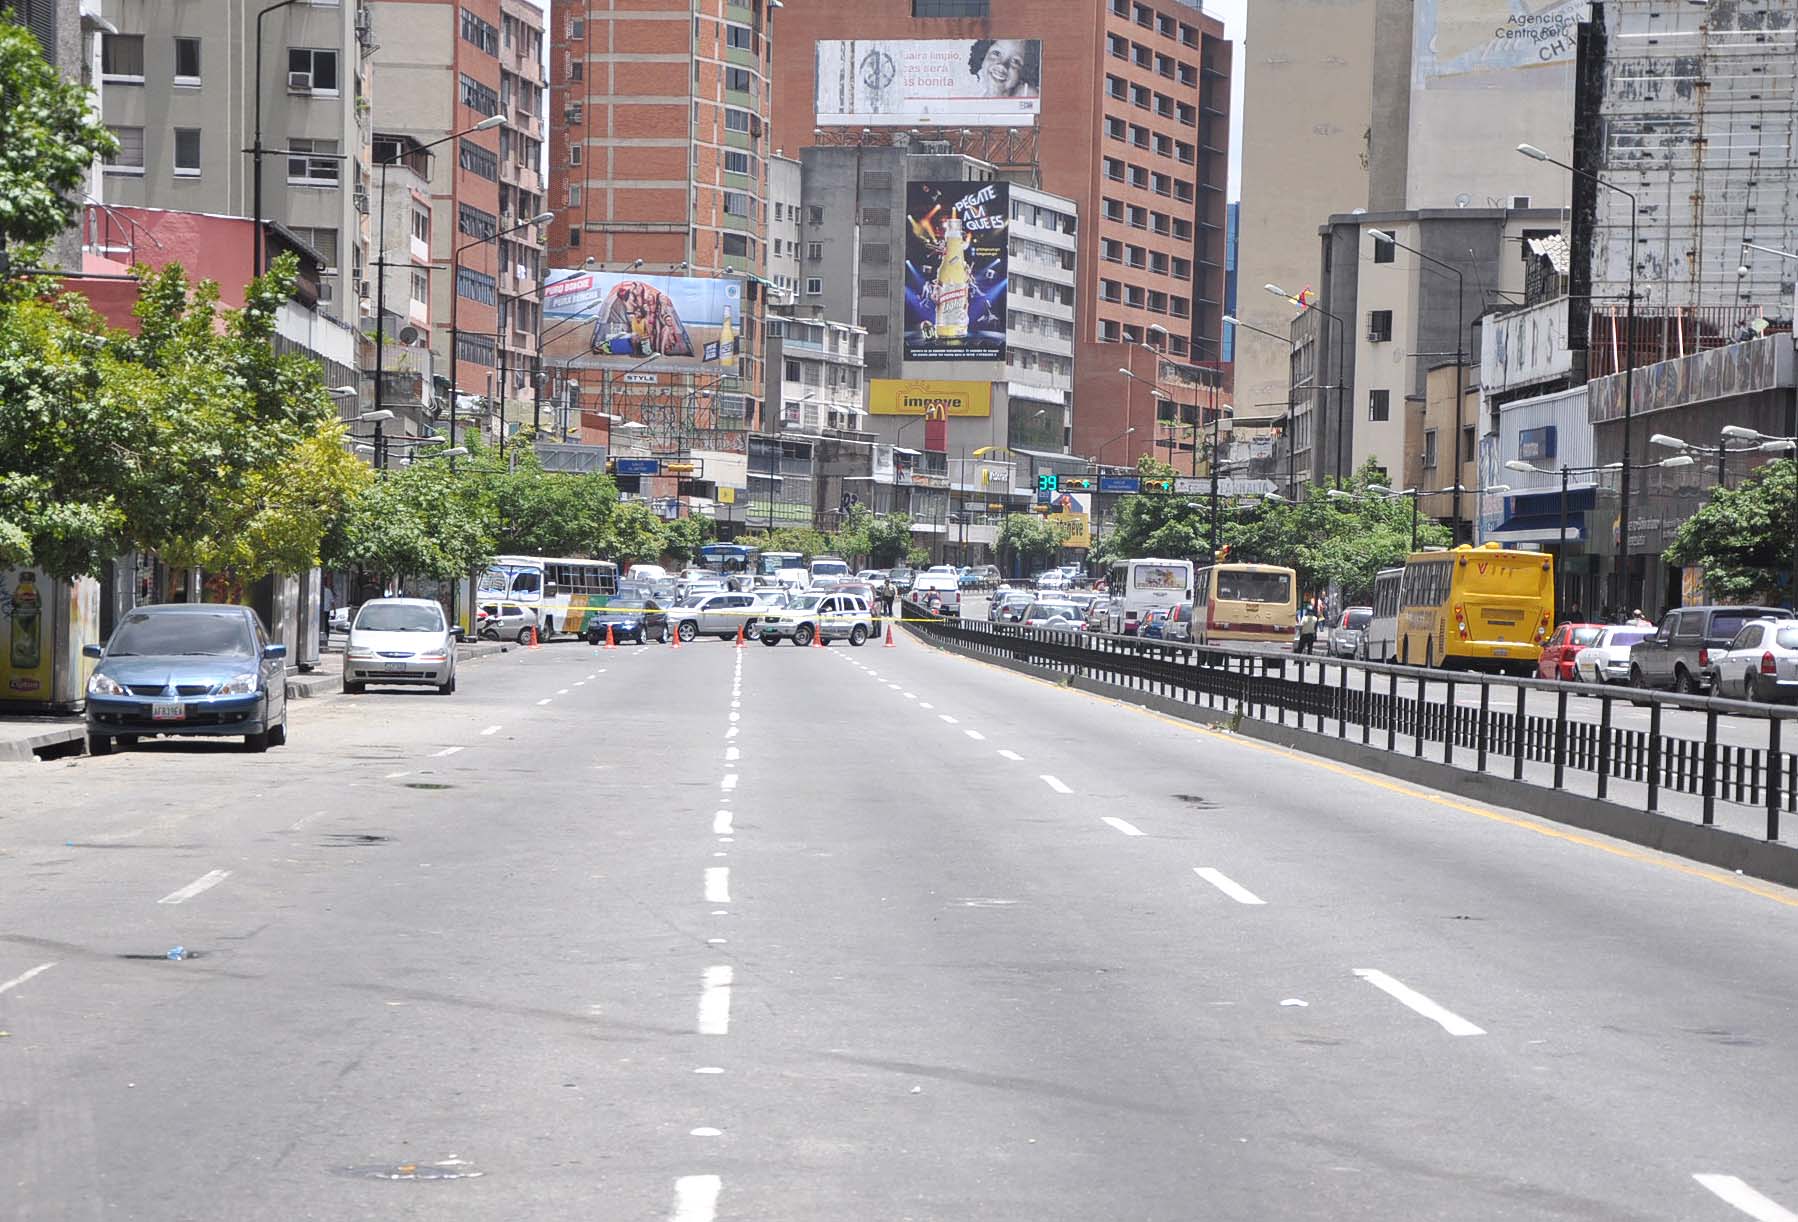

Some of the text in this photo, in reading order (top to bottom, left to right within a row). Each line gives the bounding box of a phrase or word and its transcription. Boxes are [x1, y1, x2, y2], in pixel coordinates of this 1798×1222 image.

[1507, 13, 1563, 27] Agencia
[917, 76, 954, 87] bonita
[966, 215, 1005, 231] QUE ES
[1039, 475, 1057, 491] 39
